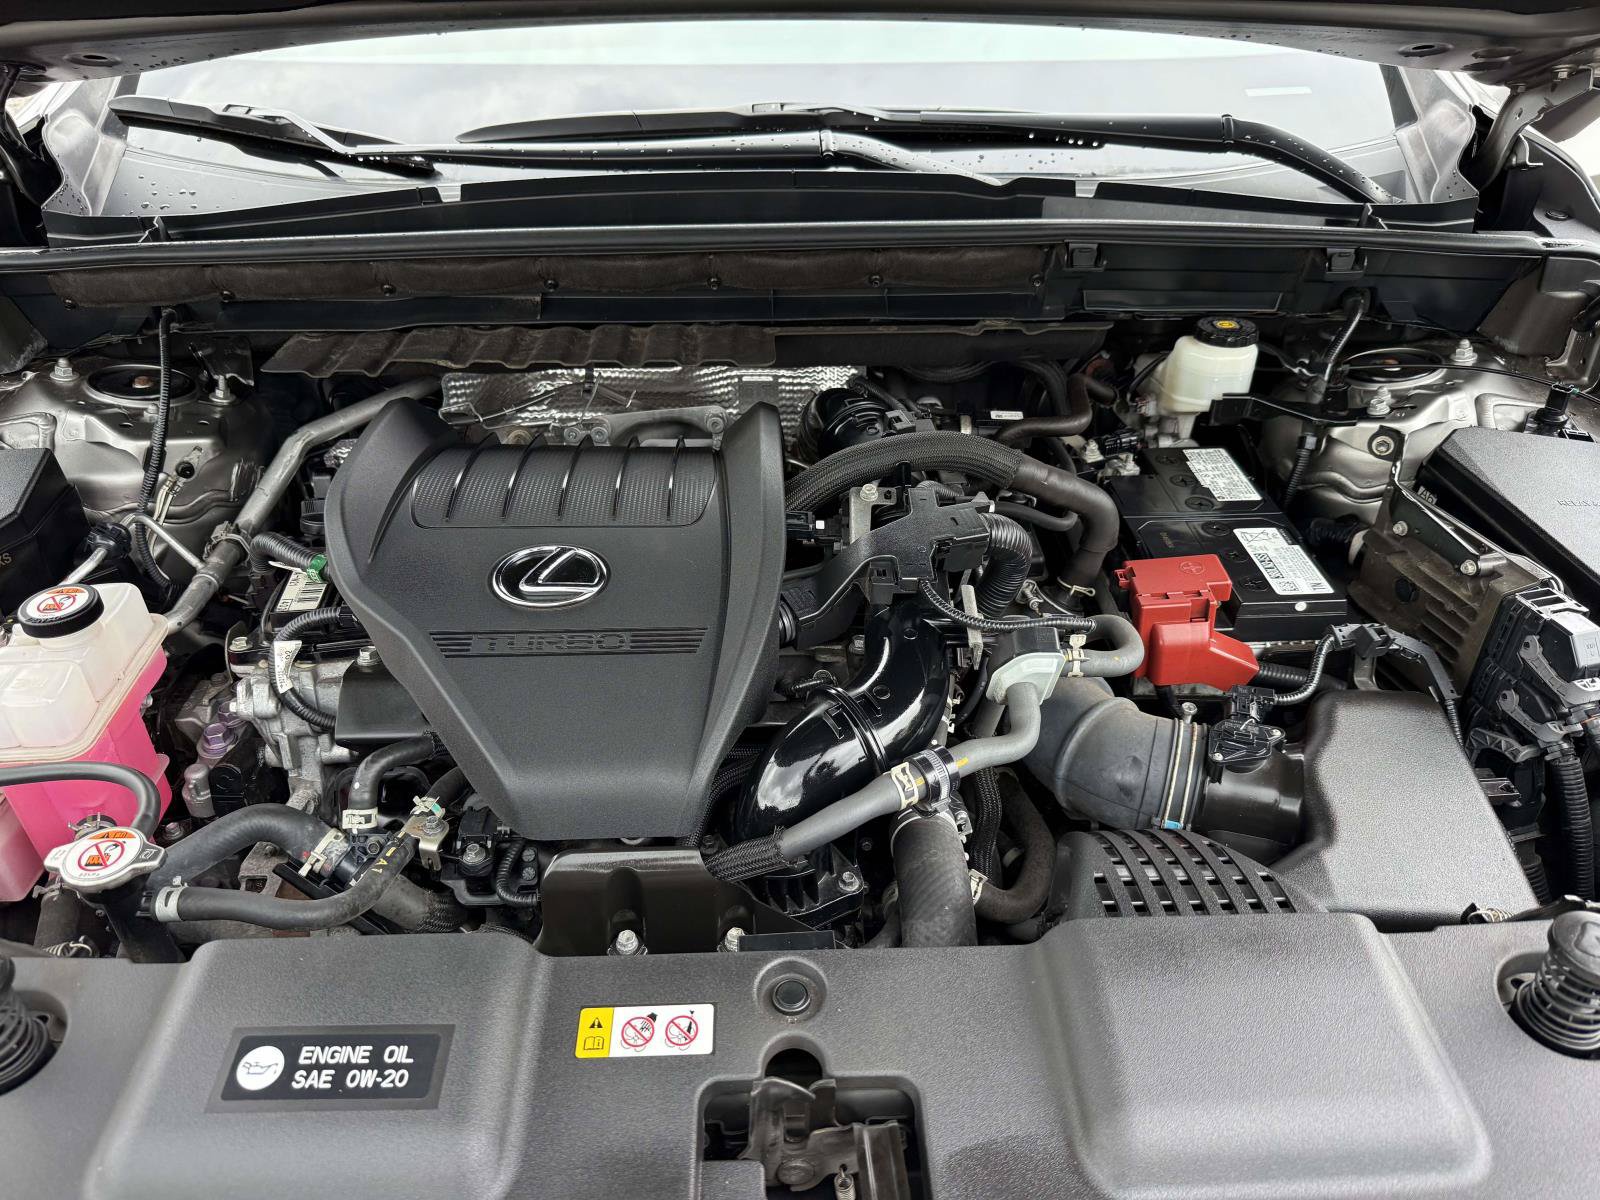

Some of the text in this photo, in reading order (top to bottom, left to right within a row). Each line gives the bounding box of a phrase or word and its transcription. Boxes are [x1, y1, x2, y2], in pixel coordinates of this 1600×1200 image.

[477, 632, 626, 651] TURBO
[298, 1045, 414, 1065] ENGINE OIL
[291, 1069, 409, 1089] SAE 0W-20
